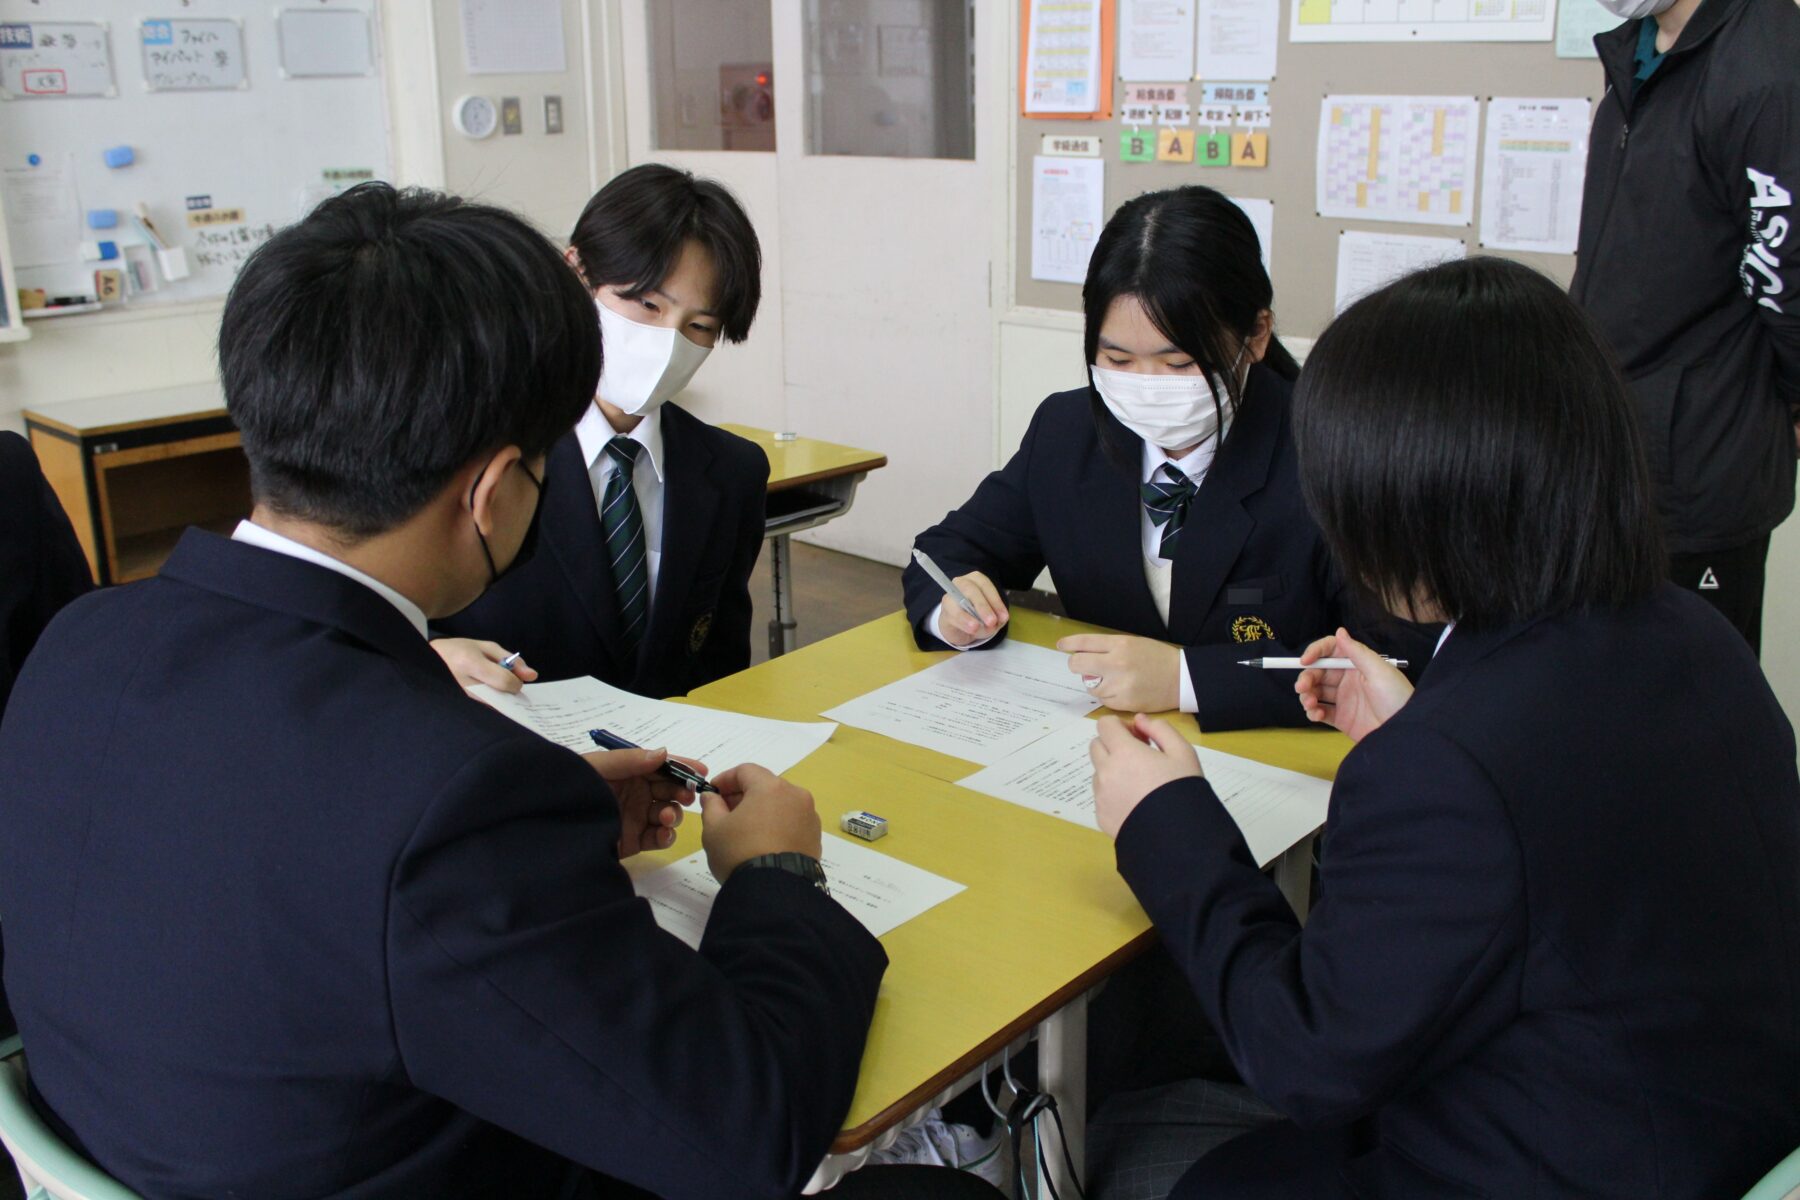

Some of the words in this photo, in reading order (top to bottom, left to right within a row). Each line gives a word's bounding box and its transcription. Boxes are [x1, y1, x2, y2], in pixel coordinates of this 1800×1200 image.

[1131, 137, 1144, 156] B
[1168, 137, 1183, 155] A
[1207, 141, 1219, 159] B
[1241, 141, 1256, 159] A
